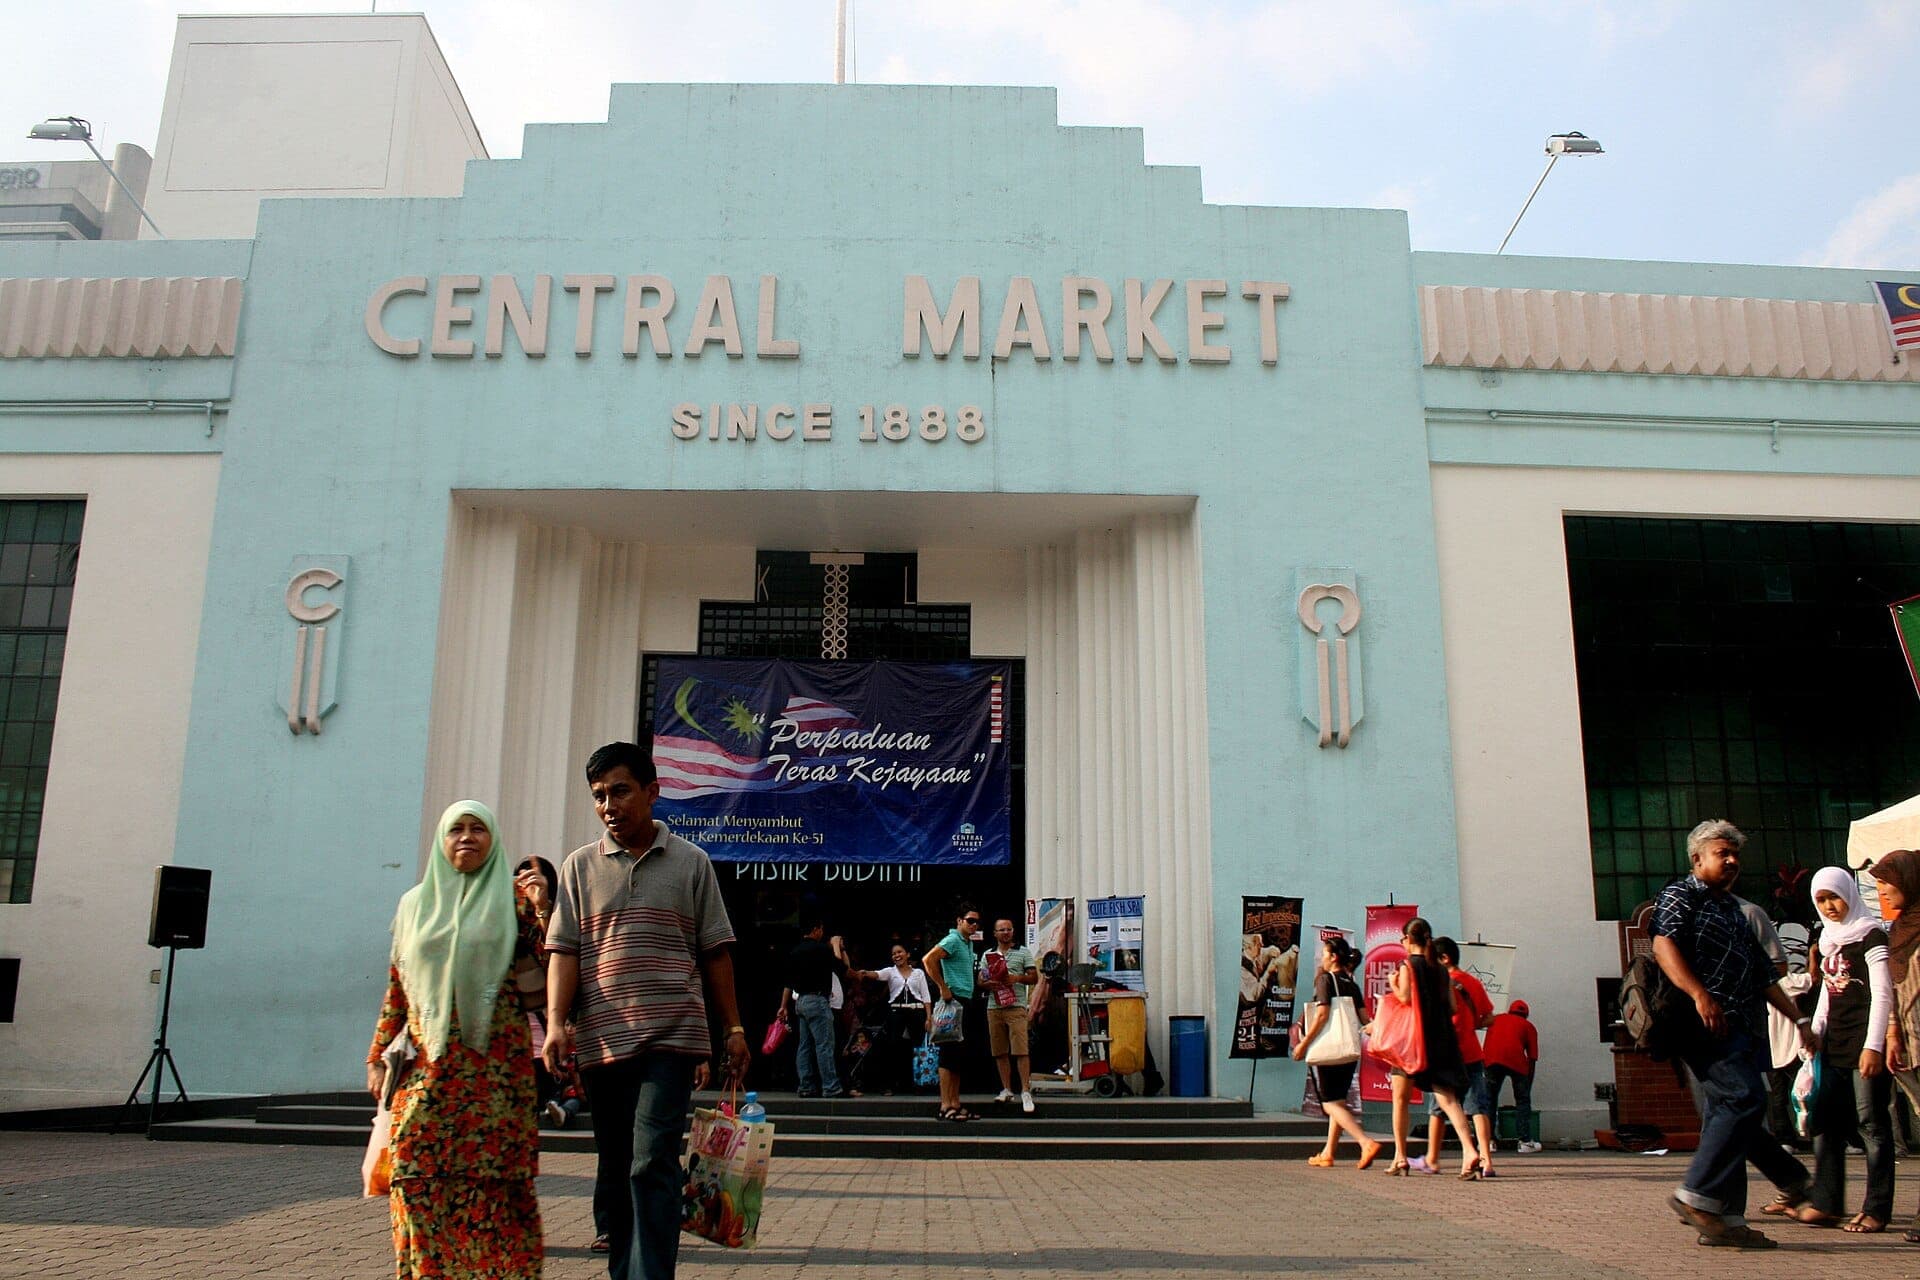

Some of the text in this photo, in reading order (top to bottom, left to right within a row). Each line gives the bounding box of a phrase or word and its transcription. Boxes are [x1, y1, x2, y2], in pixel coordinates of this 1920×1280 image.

[364, 274, 1290, 367] CENTRAL MARKET
[671, 403, 986, 444] SINCE 1888
[756, 564, 916, 604] K L
[767, 754, 838, 782] Teras
[667, 814, 805, 830] Selamat Menyambut
[673, 830, 824, 844] ari Kemerdekaan Ke-51
[1089, 900, 1140, 916] CUTE FISH SPA
[1238, 1026, 1256, 1041] 24
